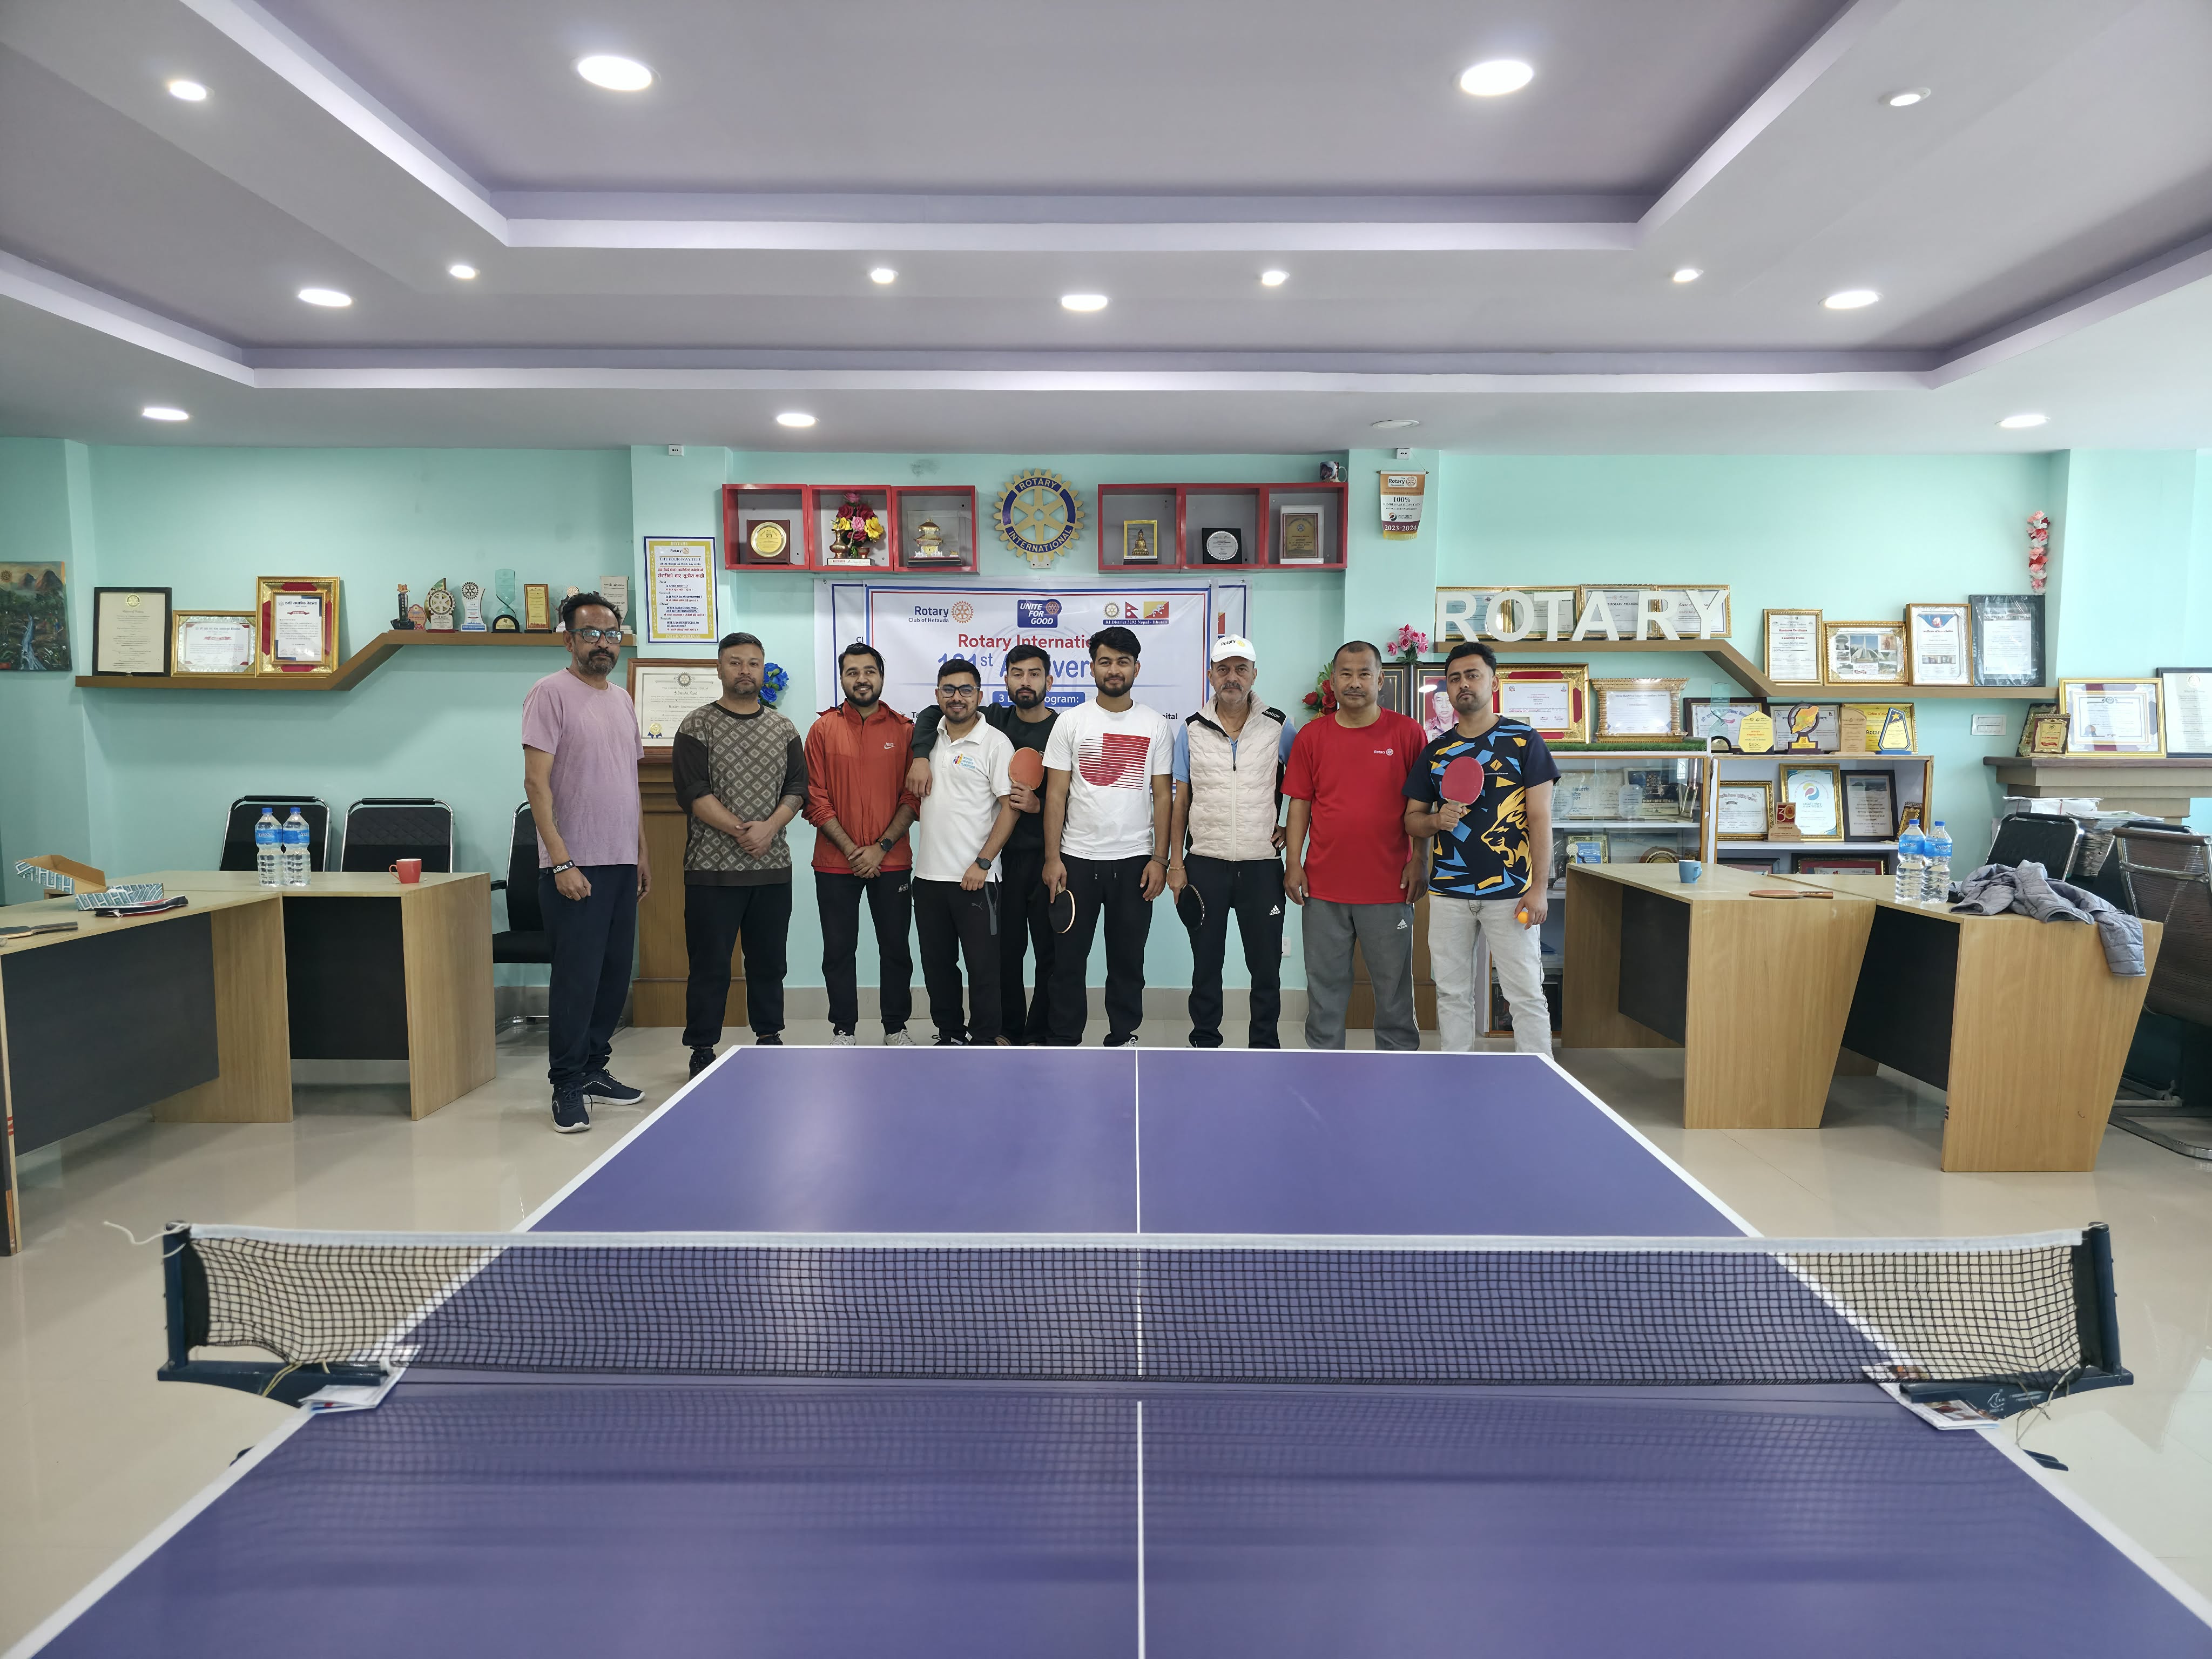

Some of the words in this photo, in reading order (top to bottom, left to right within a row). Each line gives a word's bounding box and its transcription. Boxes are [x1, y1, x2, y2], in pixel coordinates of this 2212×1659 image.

[1019, 478, 1057, 490] ROTARY
[1008, 529, 1072, 552] INTERNATIONAL
[914, 606, 949, 617] Rotary
[1435, 590, 1730, 642] ROTARY
[959, 634, 1011, 651] Rotary
[999, 694, 1004, 703] 3
[1044, 696, 1079, 705] ogram:
